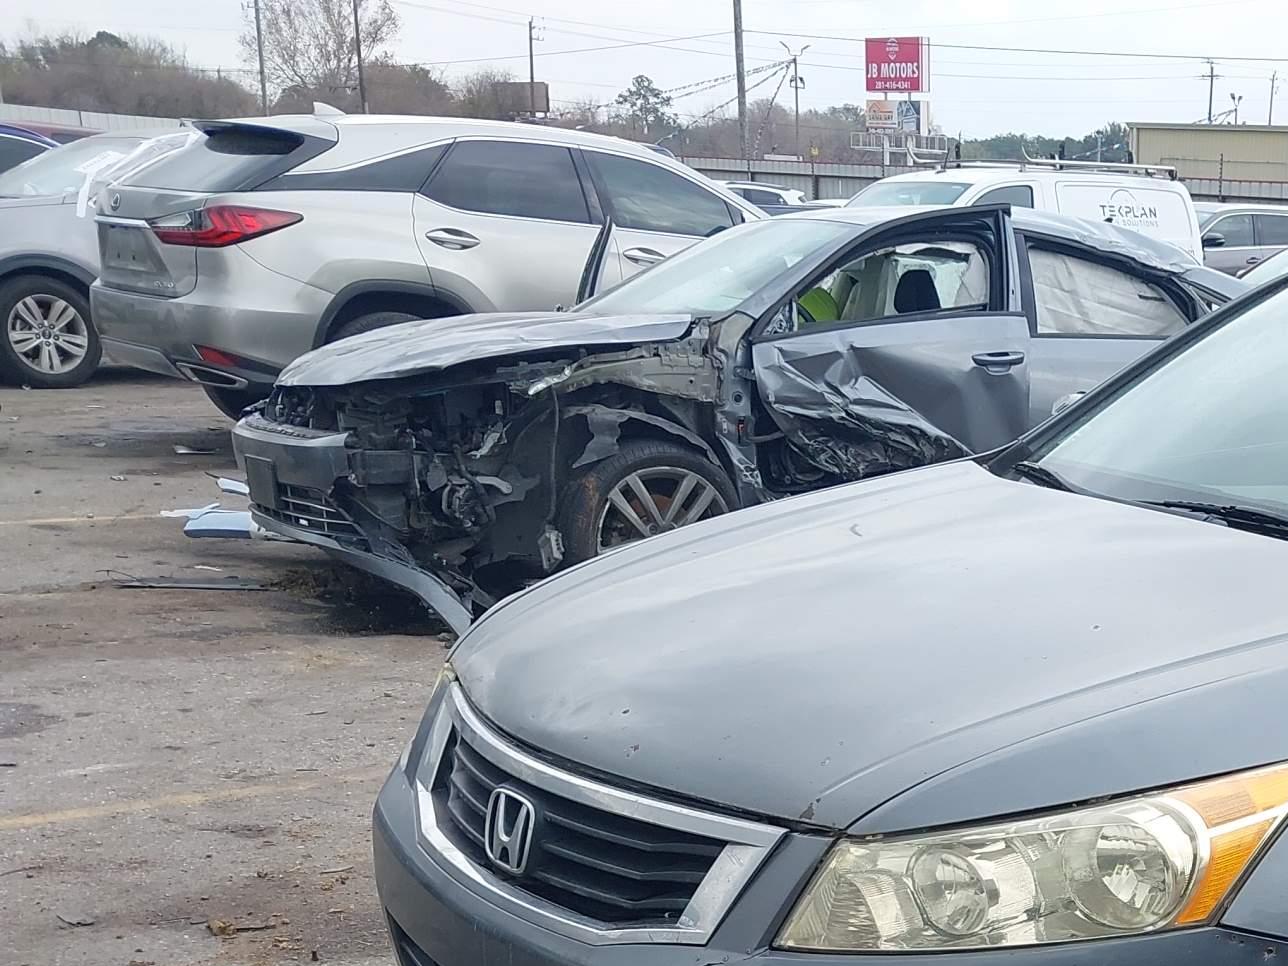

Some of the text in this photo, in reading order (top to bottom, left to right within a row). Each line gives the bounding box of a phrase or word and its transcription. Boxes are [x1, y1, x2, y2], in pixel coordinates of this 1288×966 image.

[867, 62, 919, 78] JB MOTORS
[1099, 204, 1158, 219] TEKPLAN
